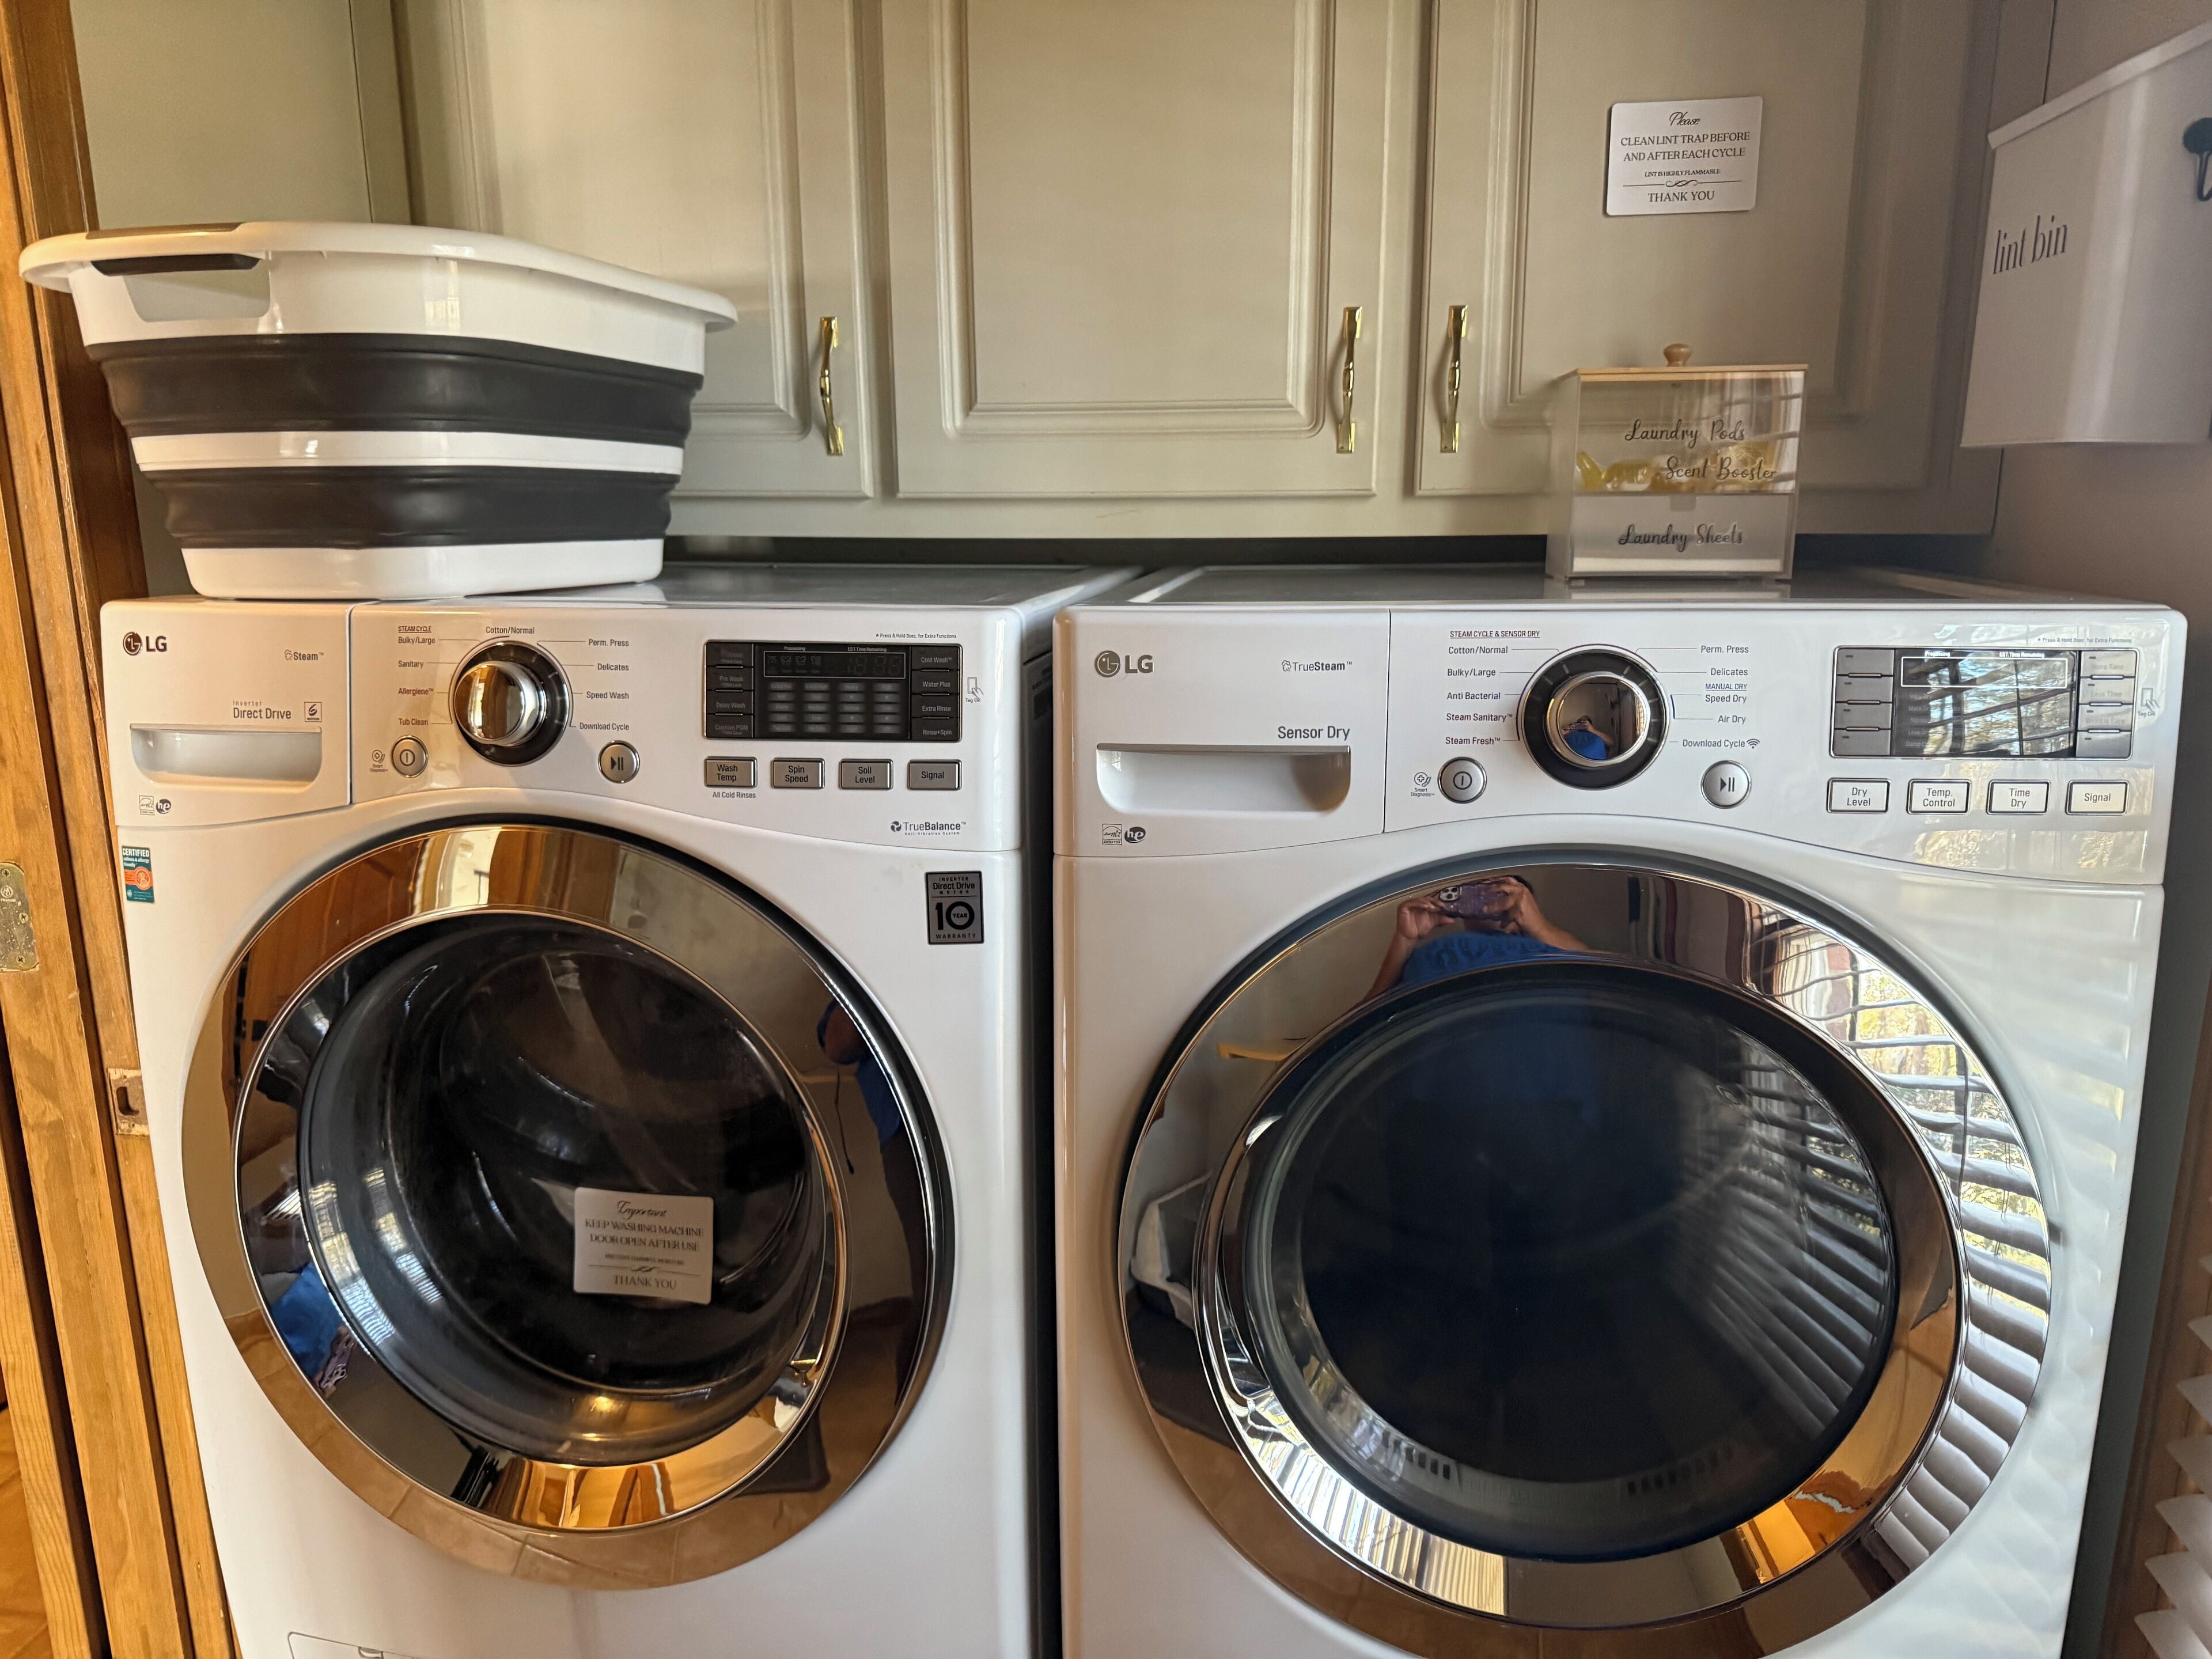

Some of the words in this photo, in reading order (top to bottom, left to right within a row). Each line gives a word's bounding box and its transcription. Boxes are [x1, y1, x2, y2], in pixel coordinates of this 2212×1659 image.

[1669, 112, 1700, 126] Please
[1620, 136, 1655, 146] CLEAN
[1656, 135, 1679, 145] LINT
[1681, 134, 1709, 144] TRAP
[1710, 131, 1750, 142] BEFORE
[1623, 152, 1646, 161] AND
[1647, 150, 1680, 161] AFTER
[1682, 149, 1710, 159] EACH
[1711, 147, 1746, 157] CYCLE
[1648, 191, 1688, 202] THANK
[1692, 190, 1714, 200] YOU
[1993, 229, 2027, 274] lint
[2031, 215, 2067, 263] bin
[1624, 419, 1699, 448] Laundry
[1710, 419, 1745, 441] Pods
[1665, 456, 1707, 480] Scent
[1717, 457, 1777, 480] Booster
[1619, 524, 1688, 552] Laundry
[1696, 523, 1743, 544] Sheets
[486, 626, 535, 634] Cotton/Normal
[146, 636, 168, 653] LG
[398, 637, 435, 645] Bulky/Large
[1448, 645, 1508, 655] Cotton/Normal
[1701, 645, 1725, 653] Perm.
[1726, 645, 1749, 653] Press
[398, 661, 424, 669] Sanitary
[597, 663, 629, 671] Delicates
[1125, 654, 1154, 674] LG
[1447, 668, 1496, 677] Bulky/Large
[1710, 668, 1748, 676] Delicates
[586, 691, 607, 700] Speed
[1447, 692, 1463, 700] Anti
[1464, 692, 1501, 700] Bacterial
[1705, 695, 1730, 704] Speed
[1732, 695, 1747, 704] Dry
[233, 708, 263, 719] Direct
[266, 708, 291, 719] Drive
[1446, 713, 1471, 721] Steam
[1718, 715, 1729, 723] Air
[1732, 715, 1747, 725] Dry
[579, 722, 611, 730] Download
[1278, 726, 1323, 740] Sensor
[1327, 726, 1350, 741] Dry
[1445, 737, 1470, 745] Steam
[1683, 739, 1721, 747] Download
[1724, 739, 1745, 748] Cycle
[717, 764, 738, 772] Wash
[788, 765, 805, 775] Spin
[858, 766, 872, 774] Soil
[785, 774, 808, 784] Speed
[855, 775, 875, 783] Level
[921, 771, 945, 781] Signal
[736, 791, 756, 800] Rinses
[1852, 787, 1868, 798] Dry
[1927, 787, 1953, 798] Temp.
[2009, 788, 2030, 797] Time
[2084, 793, 2111, 802] Signal
[1847, 797, 1870, 807] Level
[1923, 798, 1955, 808] Control
[2011, 798, 2027, 808] Dry
[122, 848, 150, 857] CERTIFIED
[935, 901, 975, 930] 10
[585, 1218, 609, 1229] KEEP
[611, 1221, 657, 1233] WASHING
[658, 1225, 704, 1237] MACHINE
[590, 1234, 619, 1243] DOOR
[620, 1236, 646, 1247] OPEN
[649, 1238, 680, 1249] AFTER
[681, 1241, 700, 1252] USE
[614, 1275, 652, 1287] THANK
[654, 1278, 677, 1290] YOU
